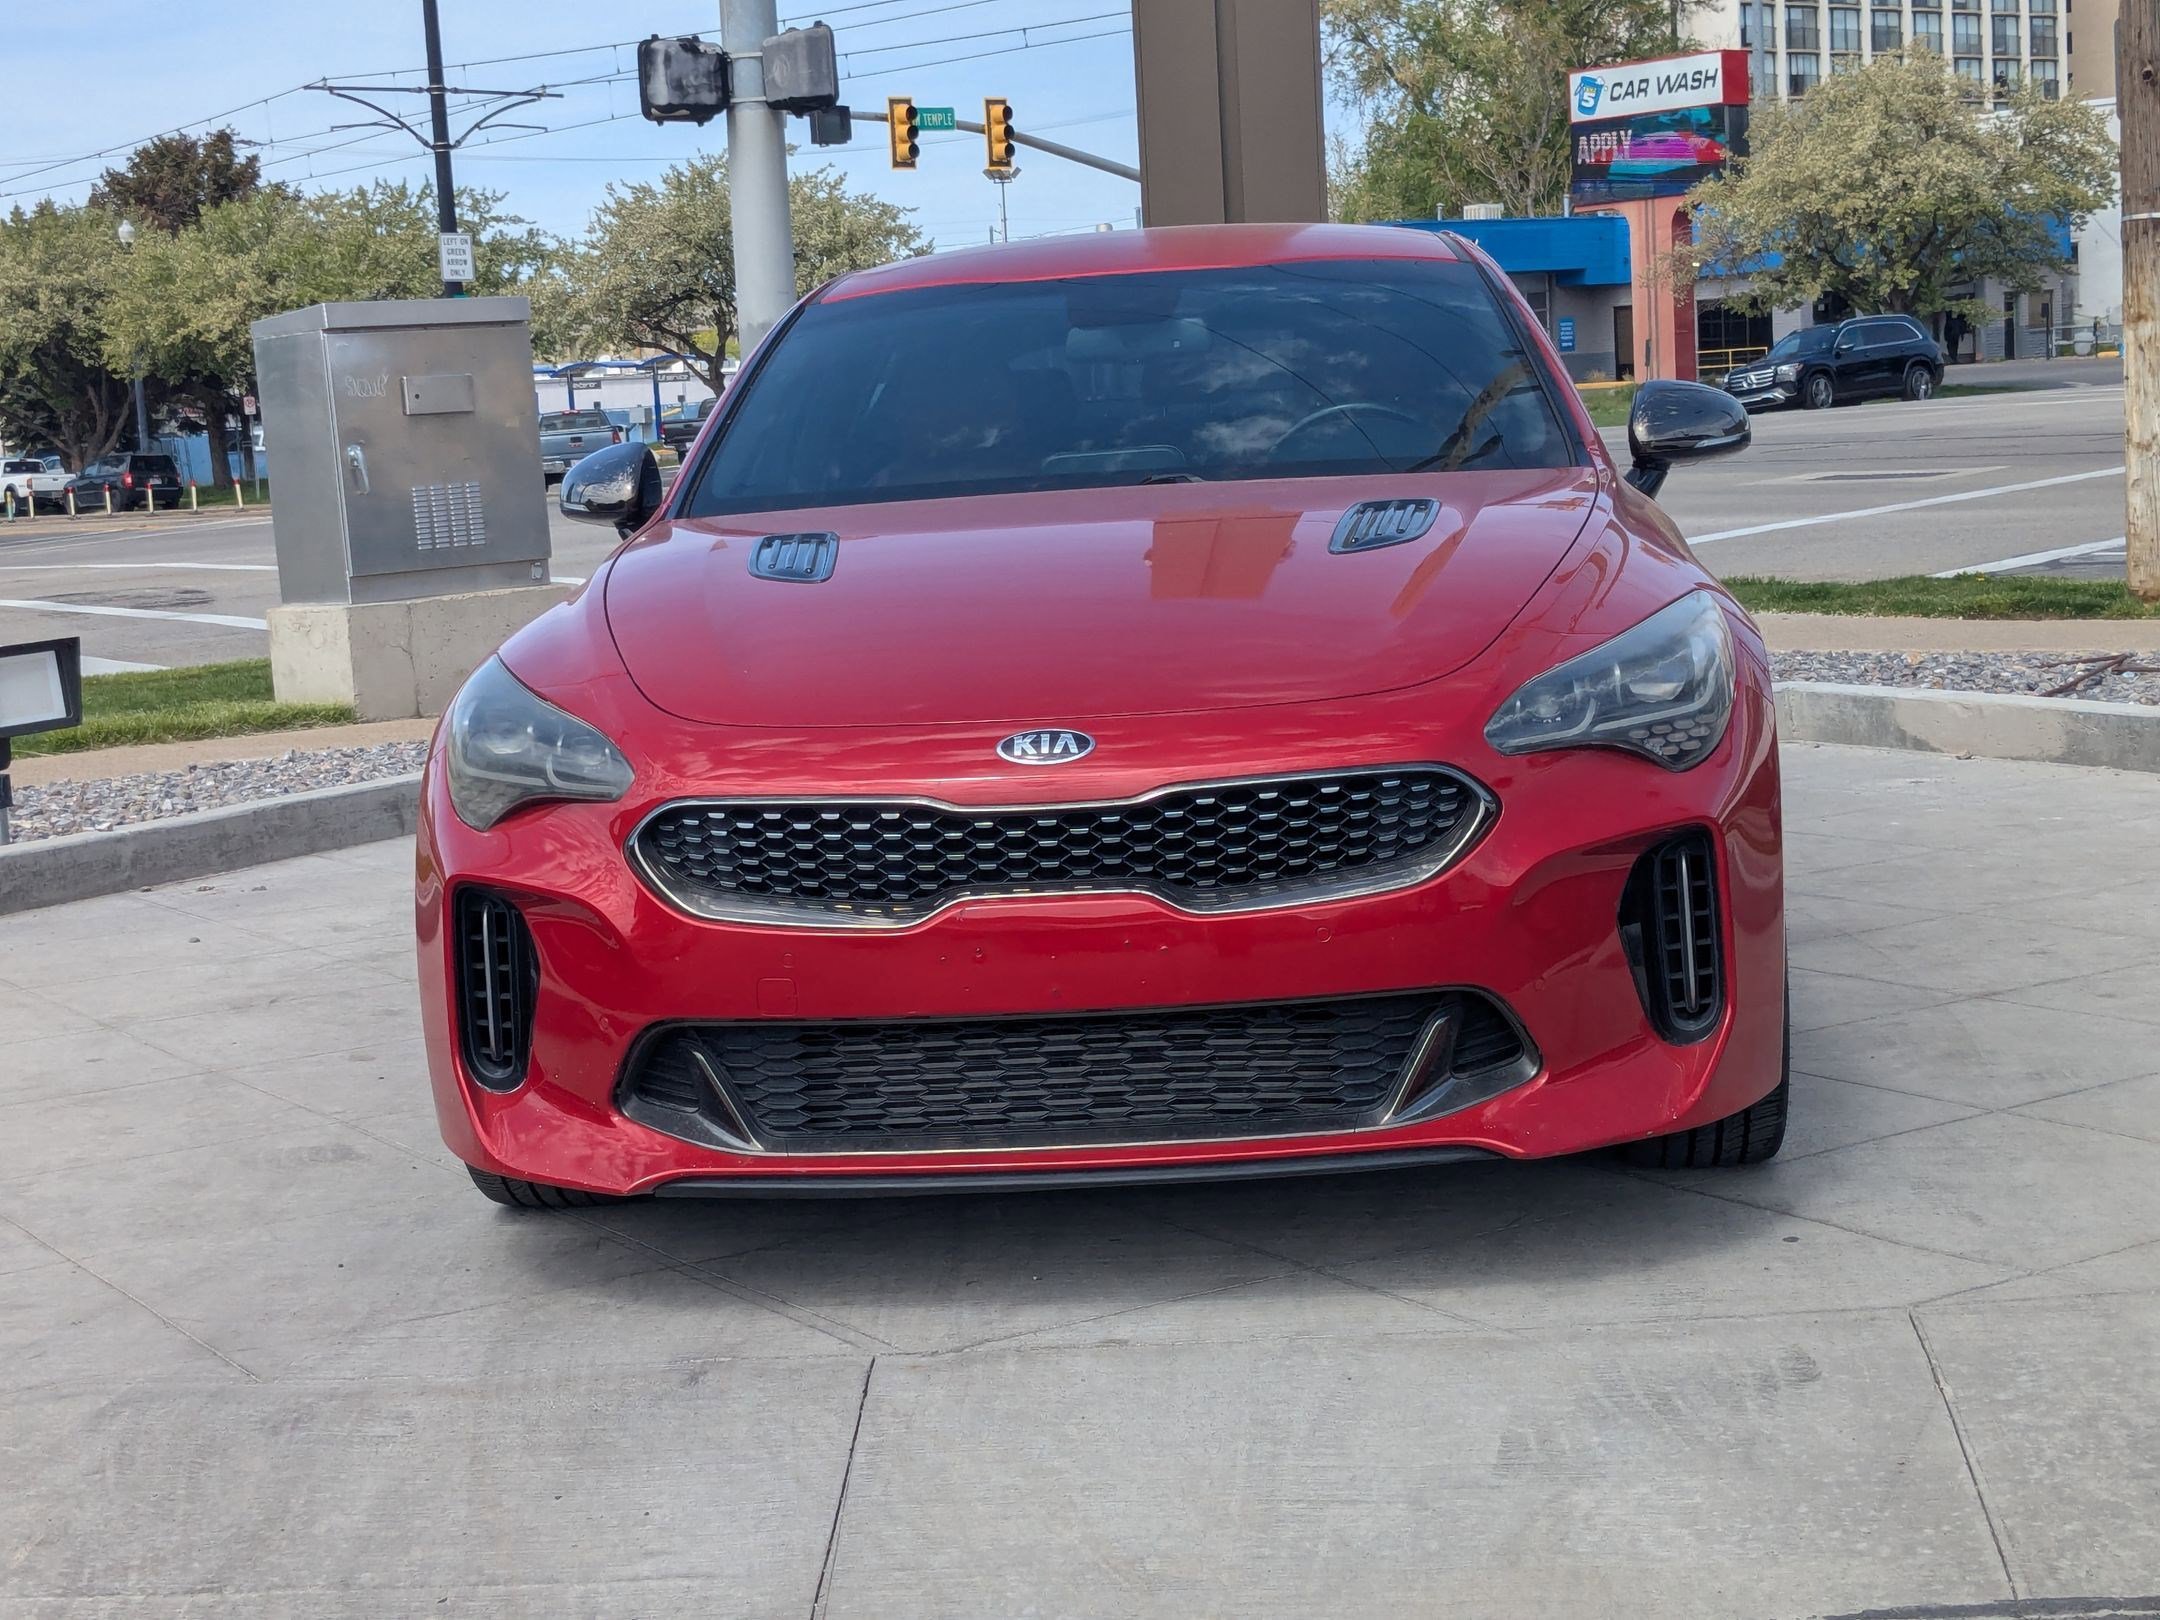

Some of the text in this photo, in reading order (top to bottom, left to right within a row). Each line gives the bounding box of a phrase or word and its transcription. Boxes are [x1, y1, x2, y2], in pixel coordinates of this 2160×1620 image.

[1609, 68, 1719, 101] CAR WASH
[1581, 92, 1596, 108] 5
[922, 112, 953, 127] TEMPLE
[1577, 129, 1633, 165] APPLY
[443, 237, 469, 246] LEFT ON
[446, 248, 467, 256] GREEN
[447, 258, 467, 266] ARROW
[450, 269, 466, 277] ONLY
[1013, 733, 1079, 756] KIA
